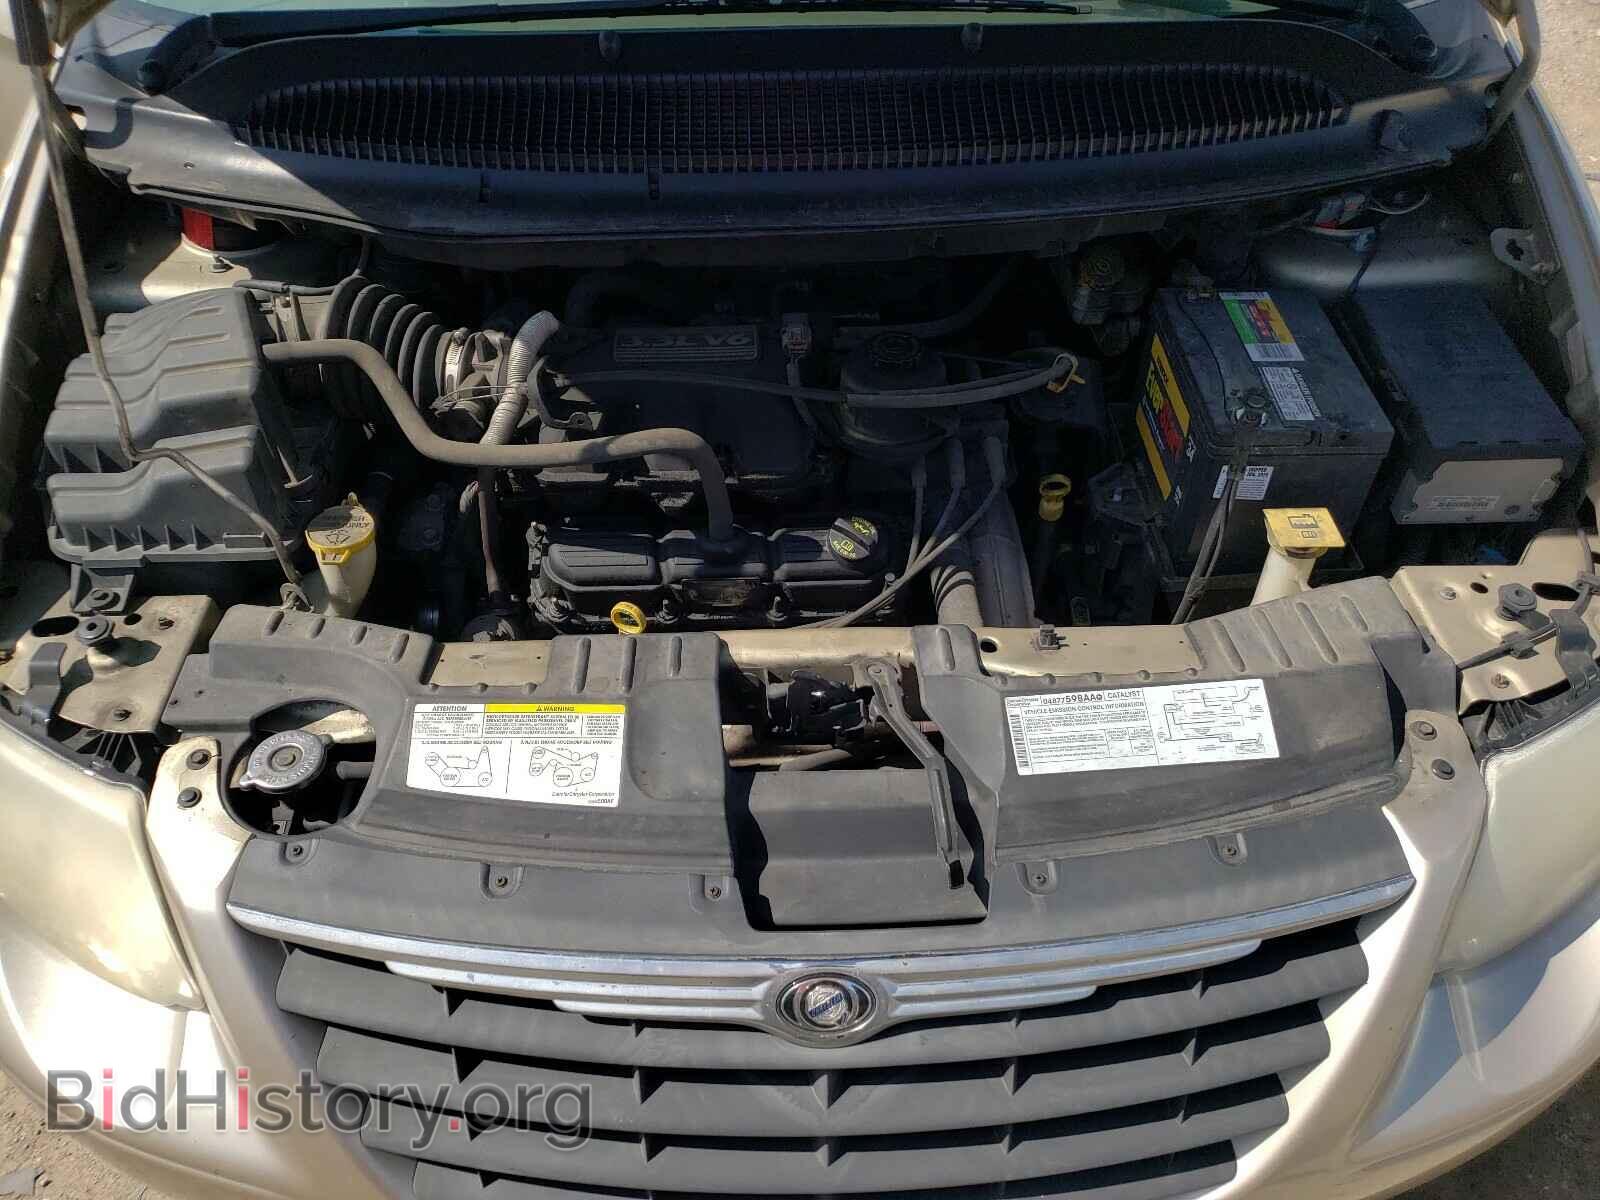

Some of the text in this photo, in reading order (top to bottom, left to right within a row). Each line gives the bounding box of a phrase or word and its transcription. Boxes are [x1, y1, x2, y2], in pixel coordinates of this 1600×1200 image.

[702, 331, 752, 346] V6
[1107, 690, 1141, 699] CATALYST
[1078, 704, 1104, 712] CONTROL
[1105, 701, 1145, 710] INFORMATION
